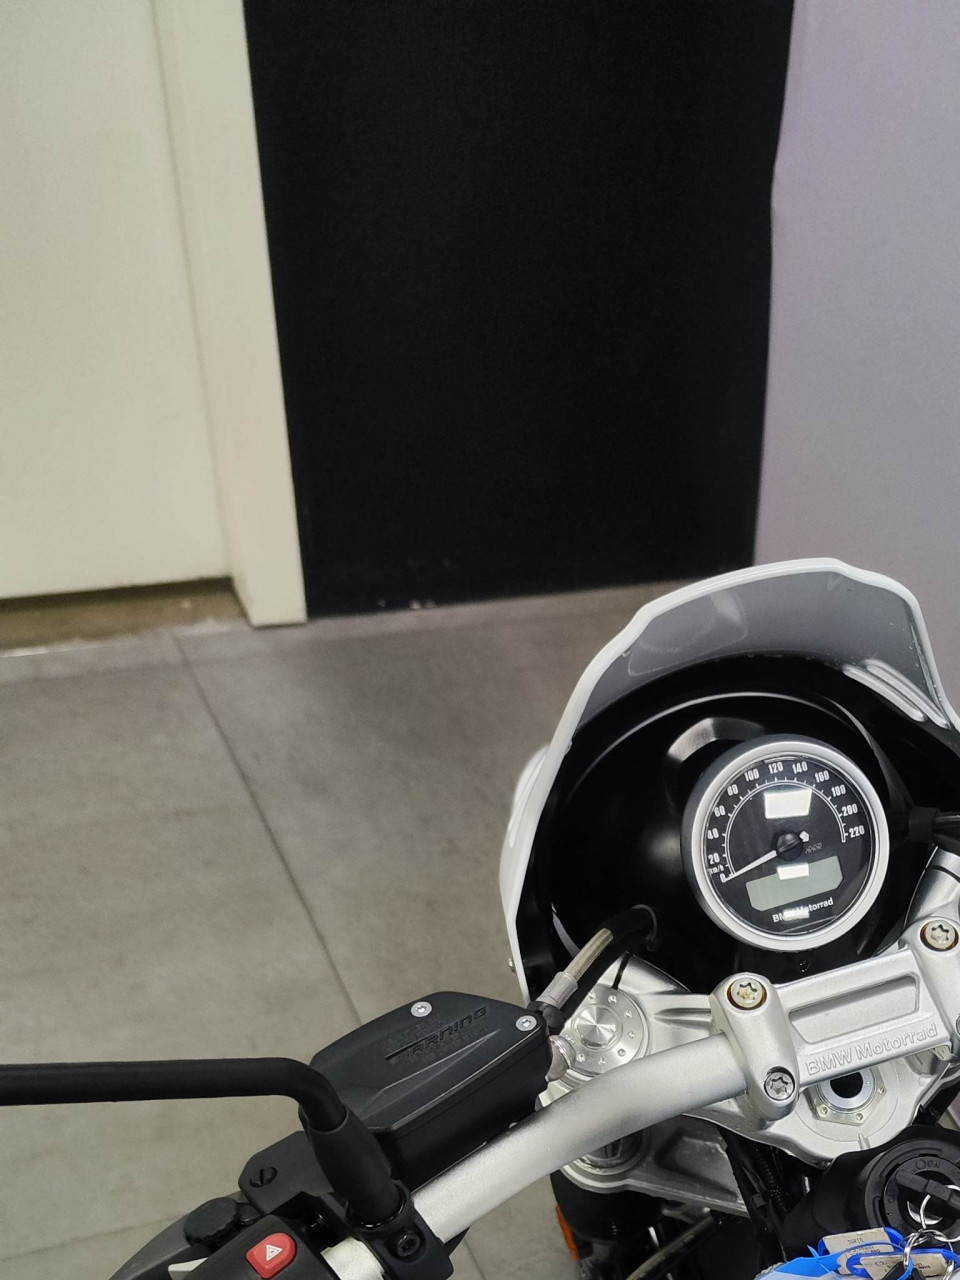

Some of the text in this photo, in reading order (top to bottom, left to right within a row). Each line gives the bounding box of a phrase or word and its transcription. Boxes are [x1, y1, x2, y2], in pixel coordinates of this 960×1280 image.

[768, 761, 784, 774] 120
[792, 761, 808, 774] 140
[744, 768, 760, 782] 100
[814, 770, 830, 783] 160
[727, 784, 739, 797] 80
[831, 784, 847, 798] 180
[714, 805, 726, 818] 60
[841, 803, 858, 817] 200
[707, 828, 720, 840] 40
[848, 825, 865, 839] 220
[708, 852, 720, 865] 20
[805, 1021, 939, 1076] BMW Motorrad
